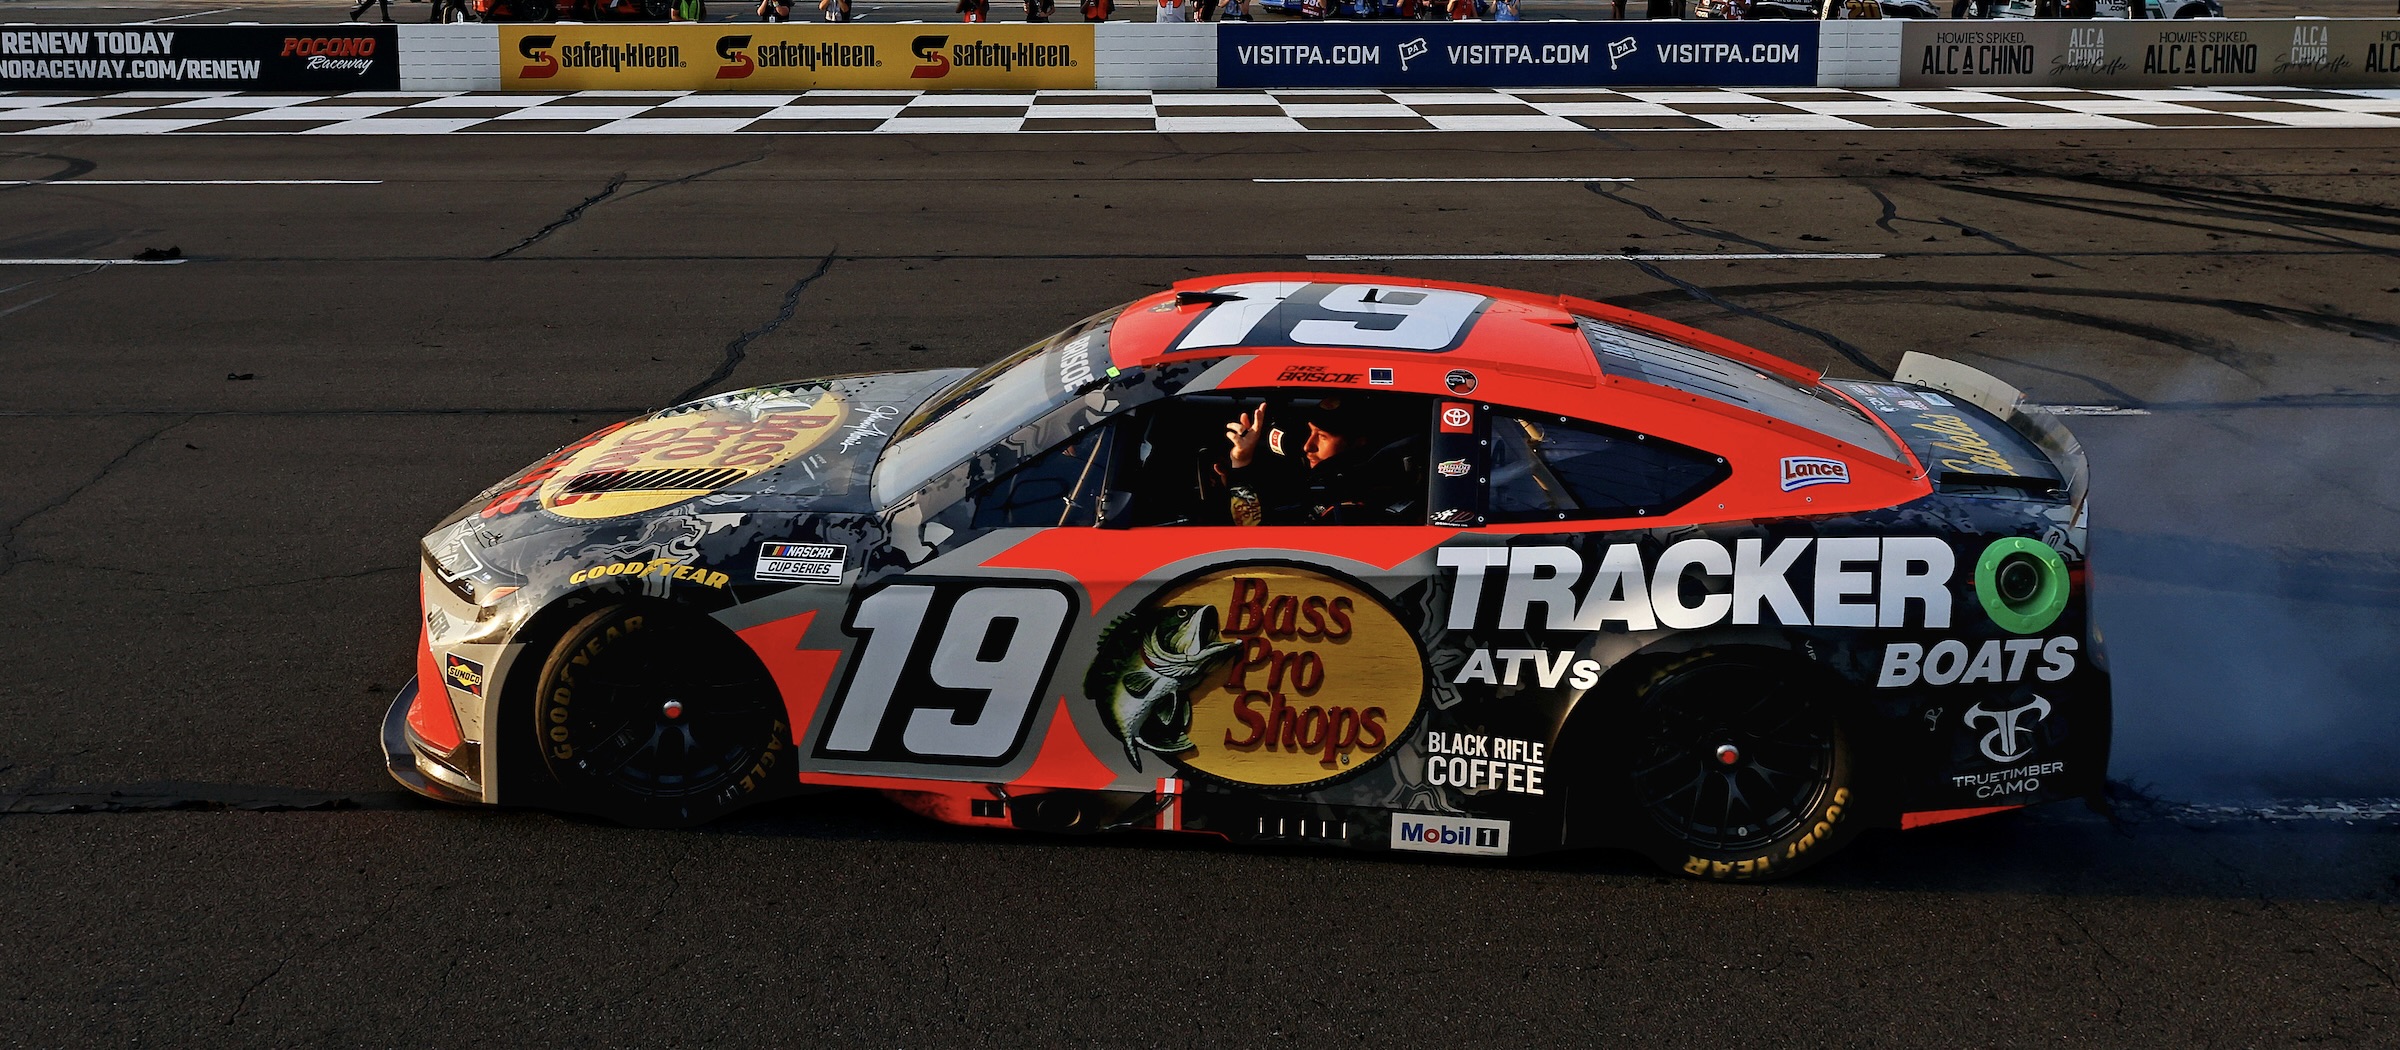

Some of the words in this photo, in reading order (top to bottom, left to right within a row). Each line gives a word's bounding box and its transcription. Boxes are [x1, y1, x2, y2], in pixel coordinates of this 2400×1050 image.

[1, 31, 89, 54] RENEW
[94, 31, 174, 54] TODAY
[281, 37, 377, 57] POCONO
[1937, 32, 1984, 43] HOWIE'S
[2159, 31, 2207, 43] HOWIE'S
[2381, 31, 2400, 42] HO
[1237, 45, 1380, 65] VISITPA.COM
[1407, 43, 1419, 55] PA
[1447, 45, 1589, 64] VISITPA.COM
[1617, 43, 1629, 55] PA
[1656, 44, 1799, 63] VISITPA.COM
[306, 55, 373, 75] Raceway
[1176, 281, 1488, 350] 19
[1060, 335, 1095, 393] BRISCOE
[1276, 372, 1365, 384] BRISCOE
[713, 413, 837, 467] Bass
[1784, 459, 1844, 481] Lance
[786, 545, 835, 559] NASCAR
[569, 557, 730, 590] GOODYEAR
[768, 561, 792, 573] CUP
[791, 562, 832, 575] SERIES
[1436, 536, 1954, 633] TRACKER
[1221, 576, 1355, 639] Bass
[825, 585, 1068, 758] 19
[1223, 636, 1325, 693] Pro
[1453, 649, 1602, 692] ATVs
[1877, 637, 2079, 689] BOATS
[449, 667, 481, 684] SUNOCO
[549, 615, 643, 760] GOODYEAR
[1223, 689, 1388, 765] Shops
[739, 719, 787, 793] EAGLE
[1428, 731, 1489, 758] BLACK
[1493, 737, 1544, 764] RIFLE
[1428, 755, 1545, 795] COFFEE
[1952, 762, 2064, 787] TRUETIMBER
[1976, 778, 2040, 798] CAMO
[1401, 822, 1471, 846] Mobil
